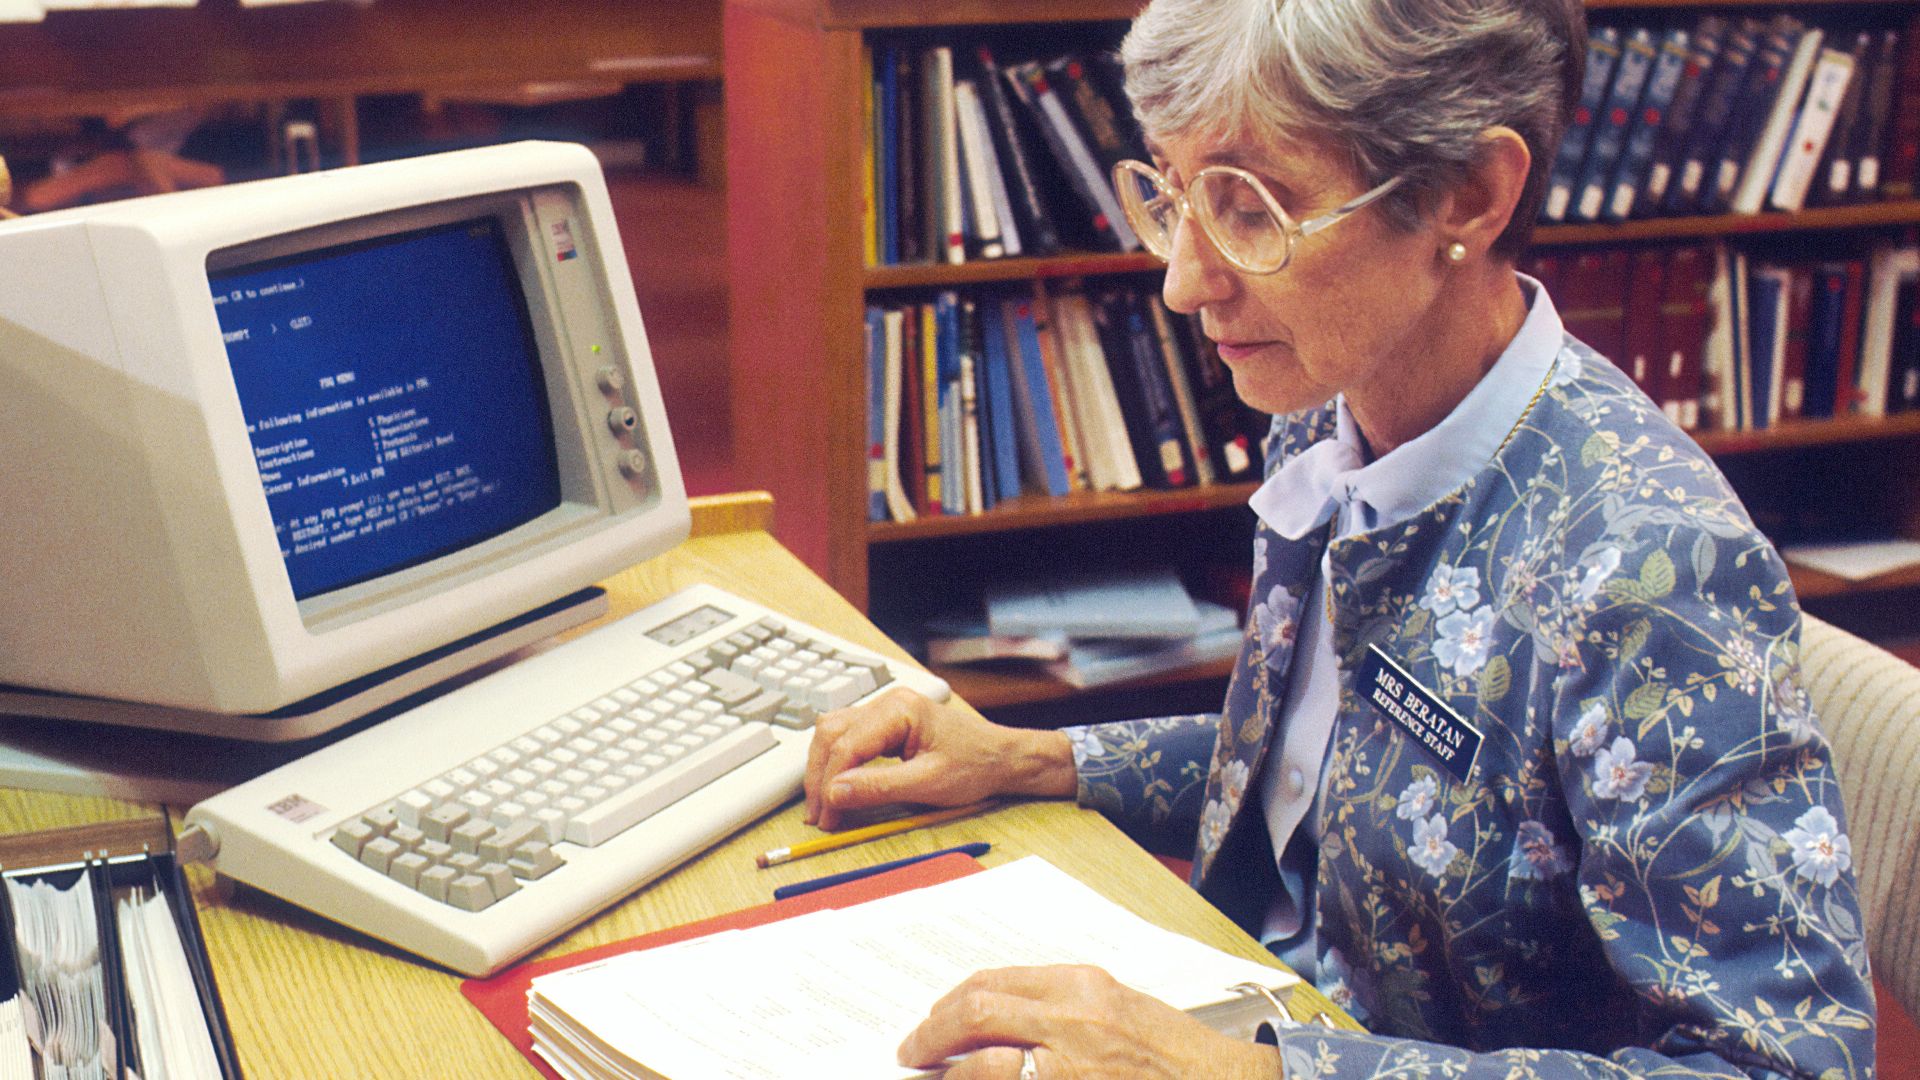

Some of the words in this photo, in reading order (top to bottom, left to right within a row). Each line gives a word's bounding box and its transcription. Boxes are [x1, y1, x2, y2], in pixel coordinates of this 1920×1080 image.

[245, 289, 257, 298] to
[336, 371, 355, 384] MENU
[259, 412, 302, 431] following
[305, 400, 353, 420] information
[357, 395, 365, 406] is
[368, 385, 403, 403] available
[377, 408, 416, 425] Physicians
[380, 416, 429, 437] Organizations
[255, 438, 308, 458] Description
[382, 431, 418, 449] Protocols
[400, 439, 433, 457] Editorial
[435, 431, 454, 446] Board
[259, 449, 315, 470] Instructions
[263, 481, 293, 496] Cancer
[297, 467, 346, 488] Information
[351, 472, 369, 486] Exit
[303, 514, 319, 527] any
[338, 499, 364, 517] prompt
[332, 520, 341, 531] or
[345, 514, 363, 528] type
[294, 535, 328, 555] desired
[330, 528, 356, 545] number
[360, 521, 373, 535] and
[376, 516, 397, 533] press
[1375, 667, 1404, 699] MRS
[1403, 692, 1465, 749] BERATAN
[1372, 687, 1425, 738] REFERENCE
[1423, 731, 1455, 761] STAFF
